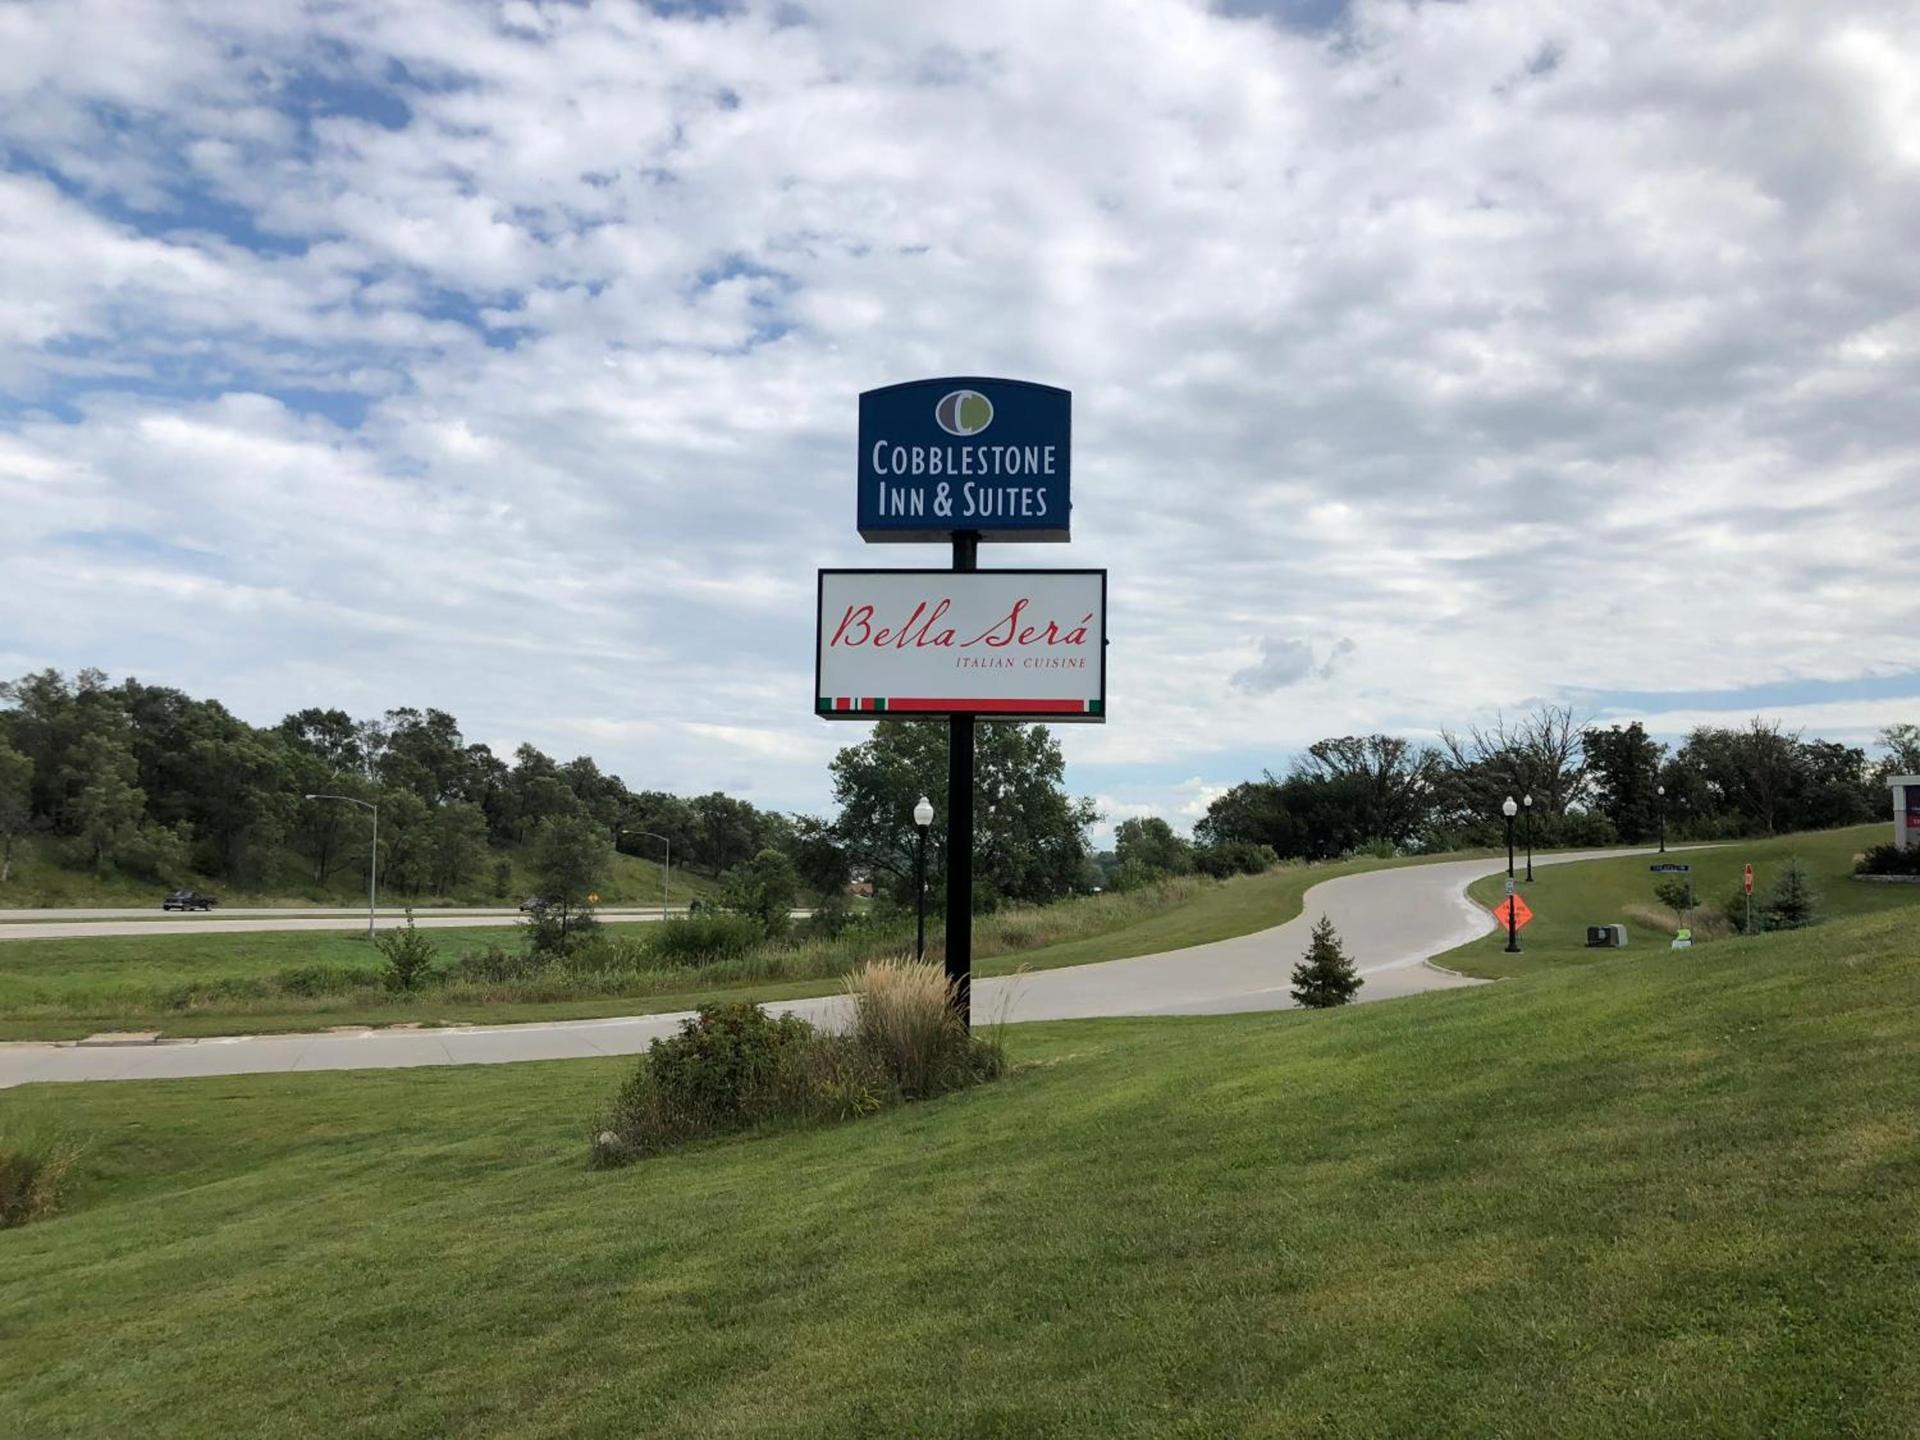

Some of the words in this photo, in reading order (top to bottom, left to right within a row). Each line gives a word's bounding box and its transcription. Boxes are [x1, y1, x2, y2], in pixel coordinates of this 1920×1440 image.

[872, 439, 1056, 475] COBBLESTONE
[879, 481, 924, 516] INN
[933, 482, 953, 517] &
[963, 481, 1047, 516] SUITES
[830, 598, 955, 649] Bella
[960, 598, 1093, 647] Será
[956, 657, 1015, 668] ITALIAN
[1023, 657, 1087, 668] CUISINE
